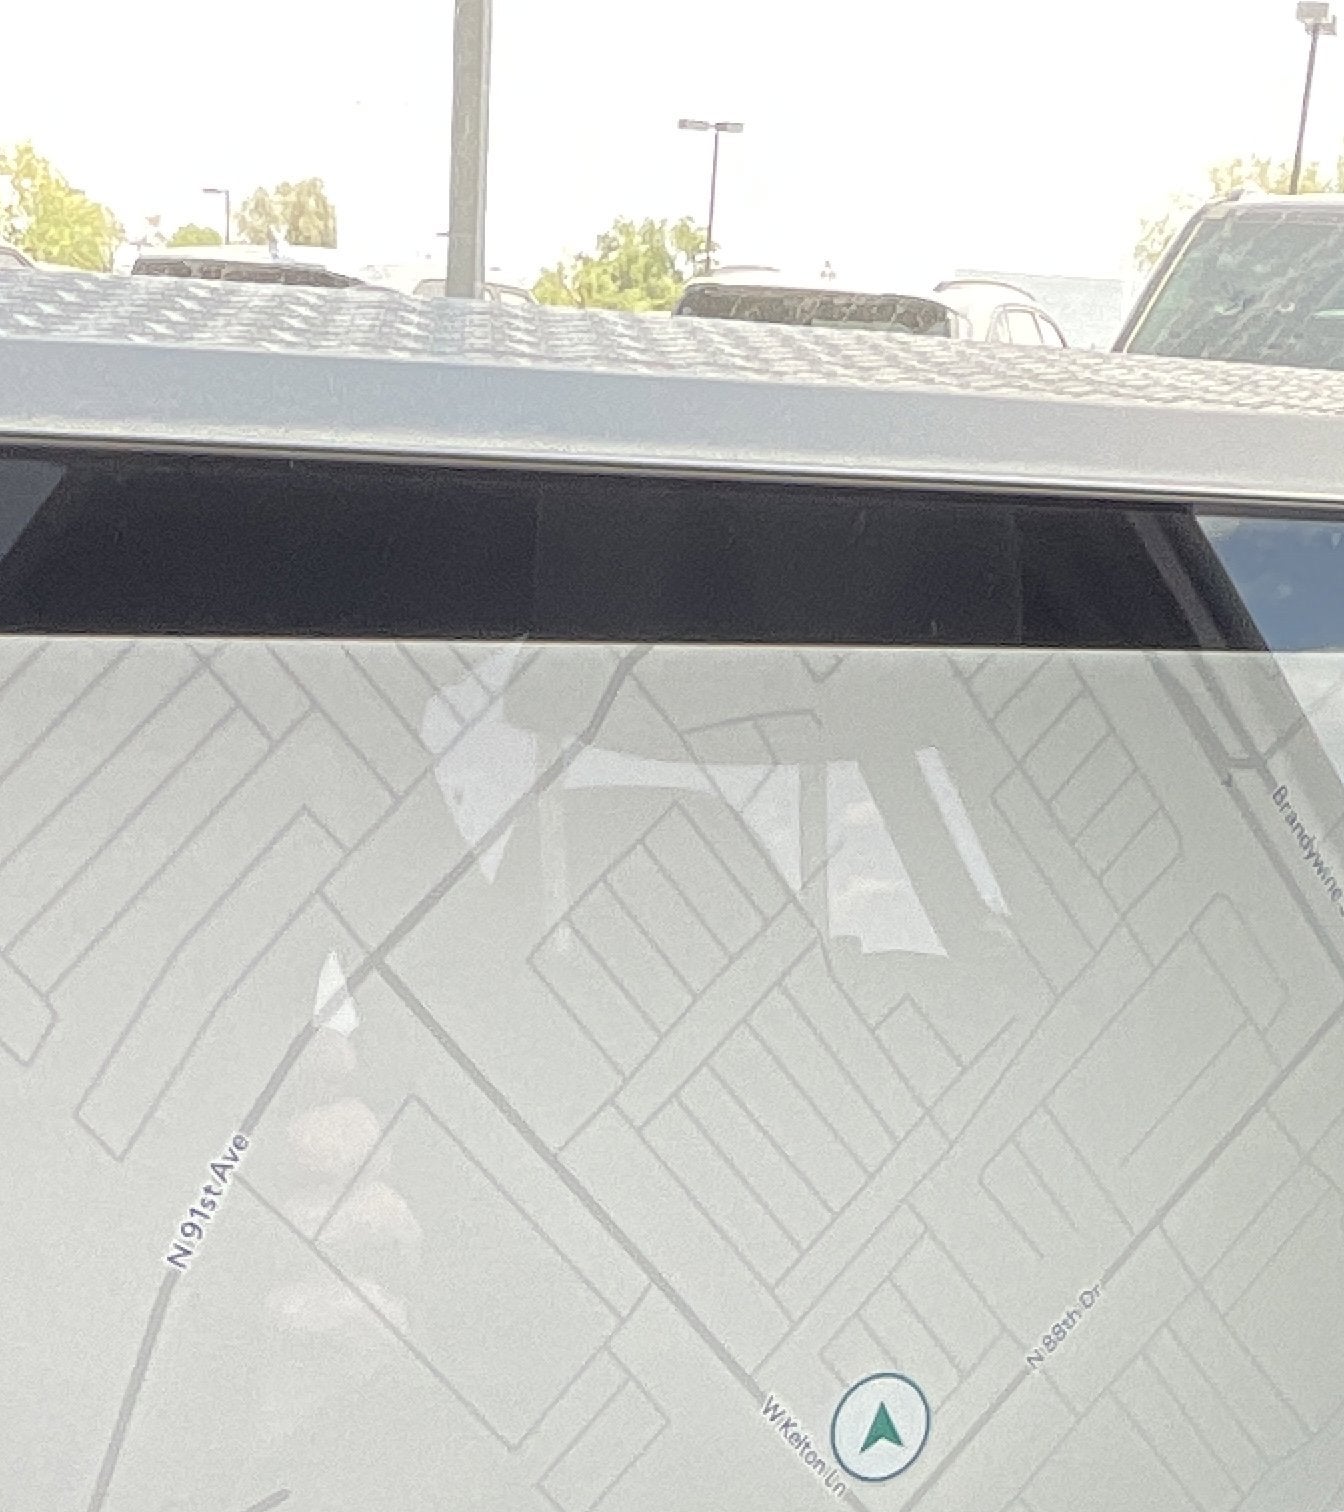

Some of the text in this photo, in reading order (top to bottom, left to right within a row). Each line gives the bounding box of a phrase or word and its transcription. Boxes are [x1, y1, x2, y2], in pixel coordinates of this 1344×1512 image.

[1272, 785, 1343, 902] Brandywine
[166, 1134, 250, 1269] N 91st Ave
[1026, 1284, 1100, 1370] N 88th Dr
[762, 1394, 787, 1422] W
[778, 1416, 826, 1476] Kelton
